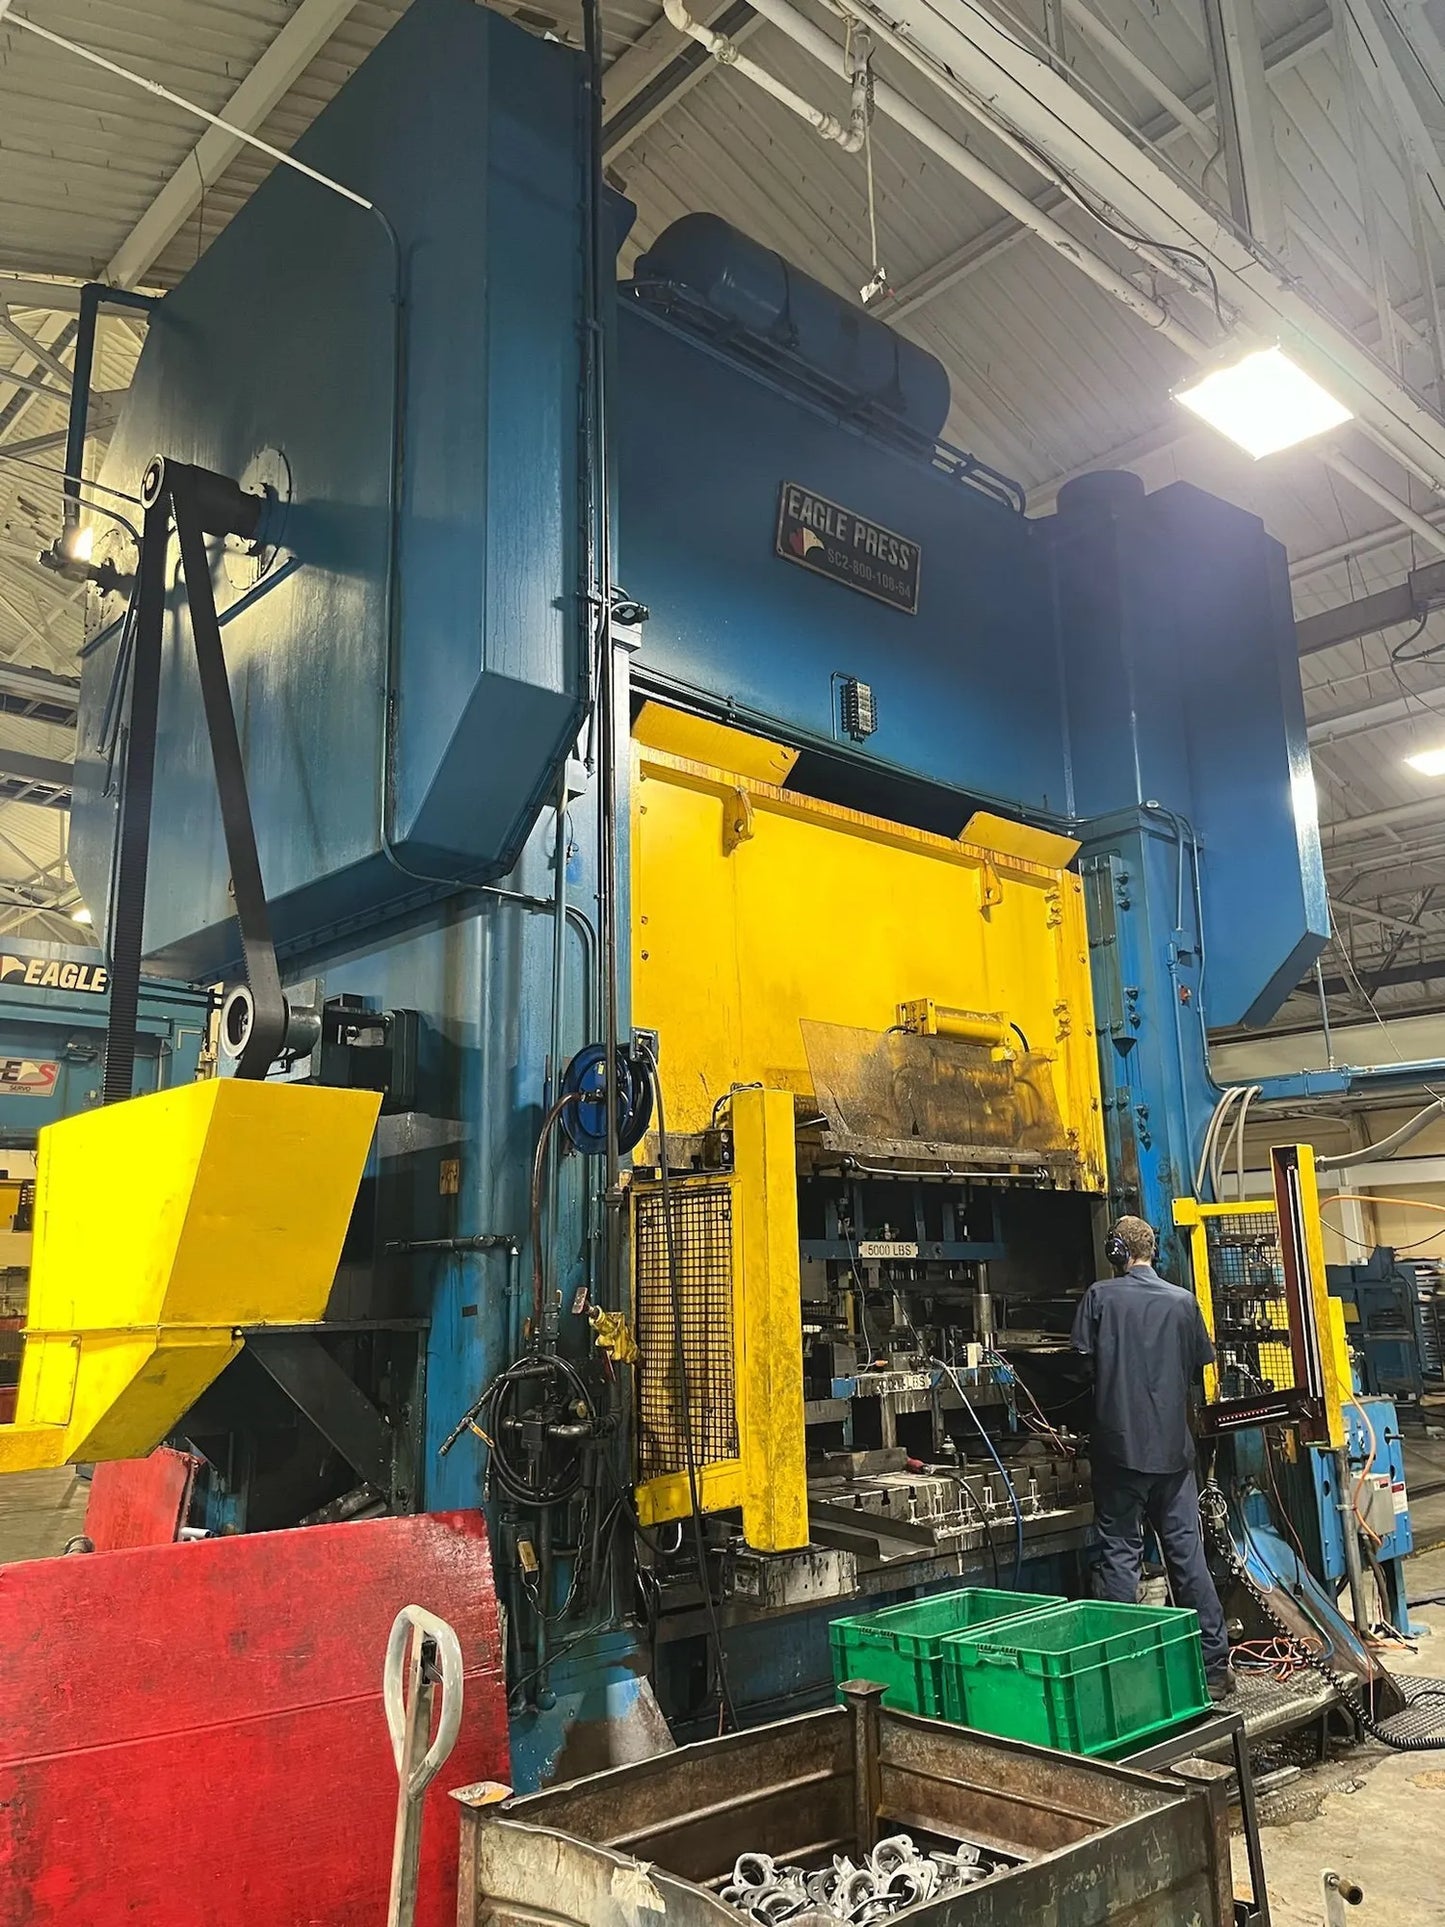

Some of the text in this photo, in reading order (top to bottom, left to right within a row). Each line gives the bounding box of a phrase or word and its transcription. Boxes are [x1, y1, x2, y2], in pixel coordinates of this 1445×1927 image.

[788, 489, 911, 571] EAGLE PRESS
[23, 959, 107, 992] EAGLE
[868, 1244, 912, 1256] 5000 LBS
